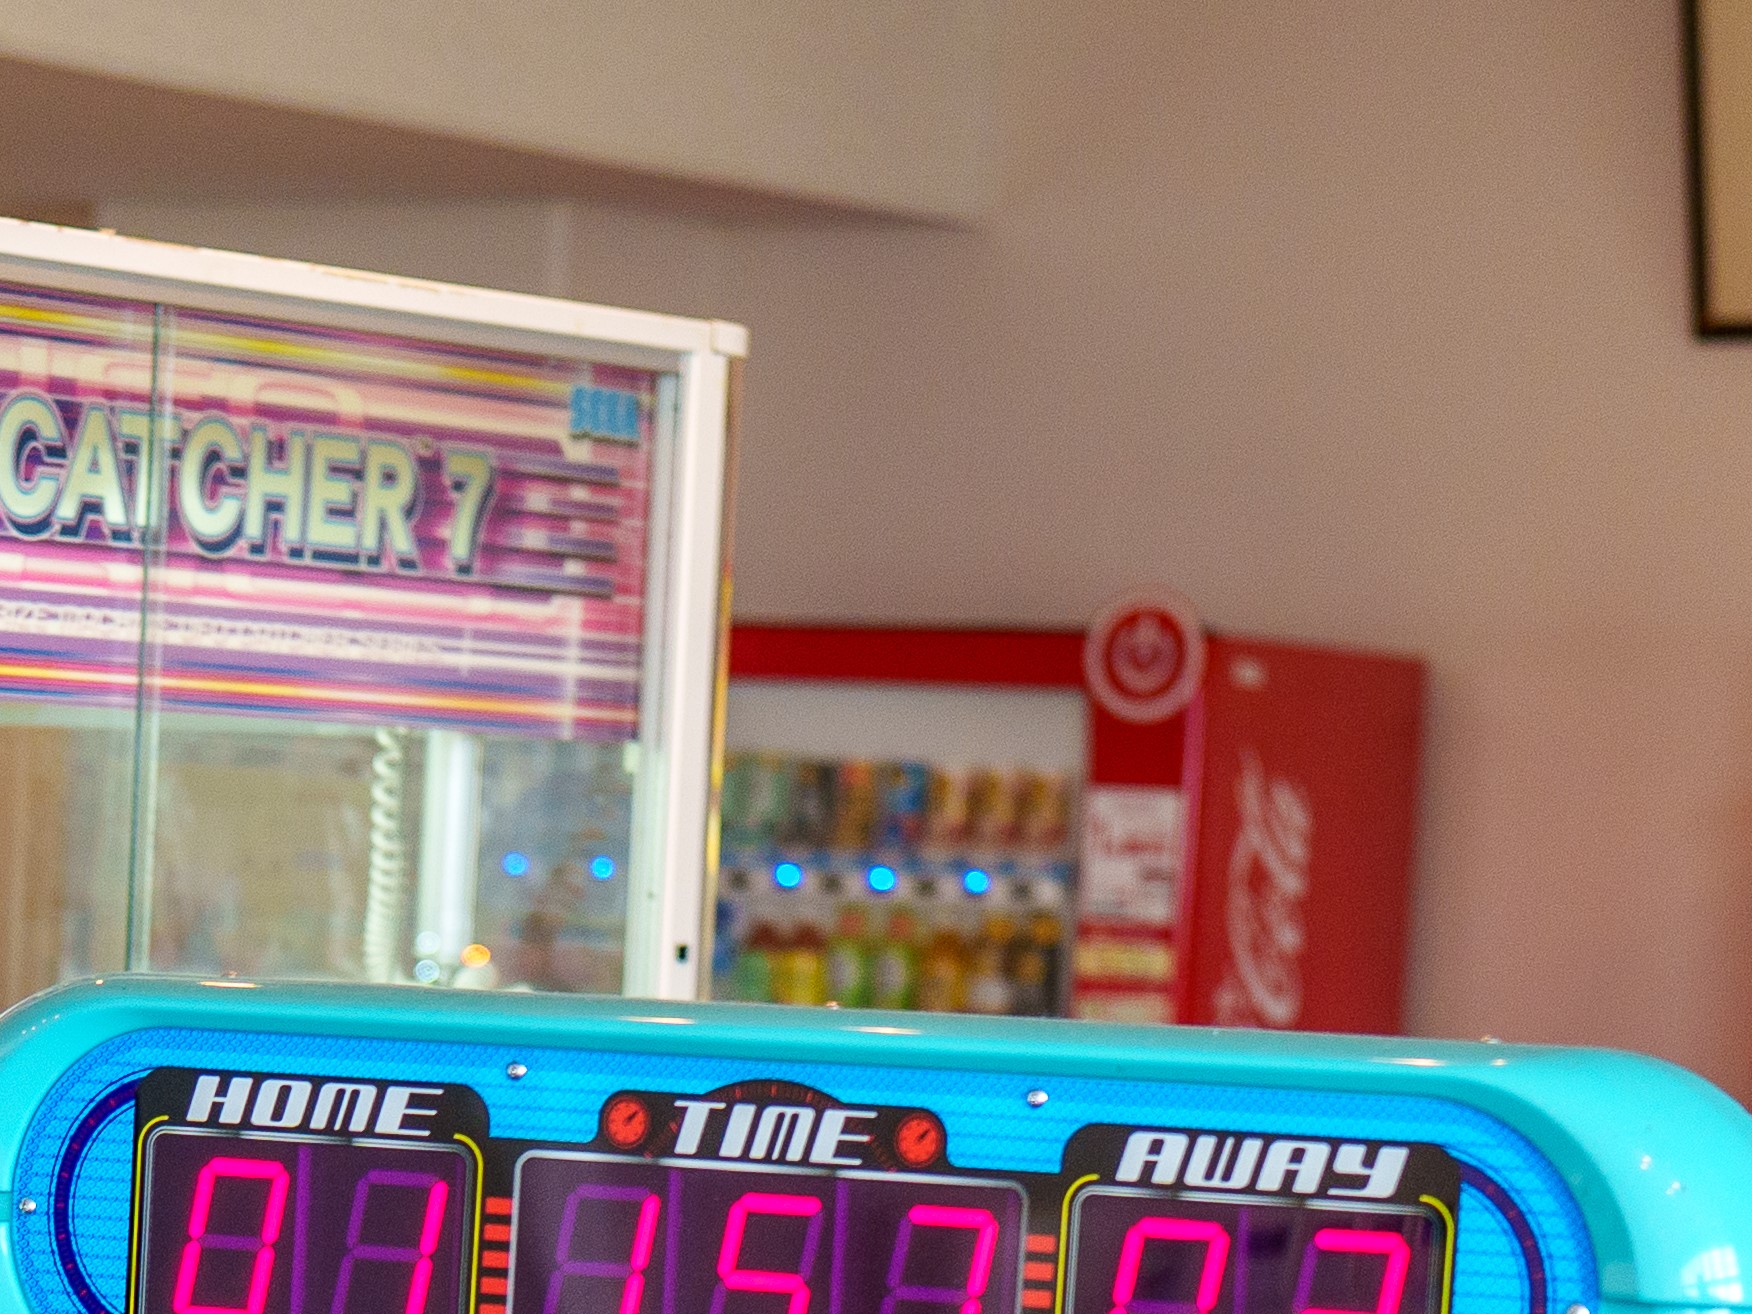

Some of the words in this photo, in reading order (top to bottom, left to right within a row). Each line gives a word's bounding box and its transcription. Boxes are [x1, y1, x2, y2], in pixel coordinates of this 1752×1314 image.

[441, 448, 496, 574] 7
[186, 1074, 445, 1137] HOME
[673, 1099, 879, 1166] TIME
[1114, 1130, 1410, 1199] AWAY
